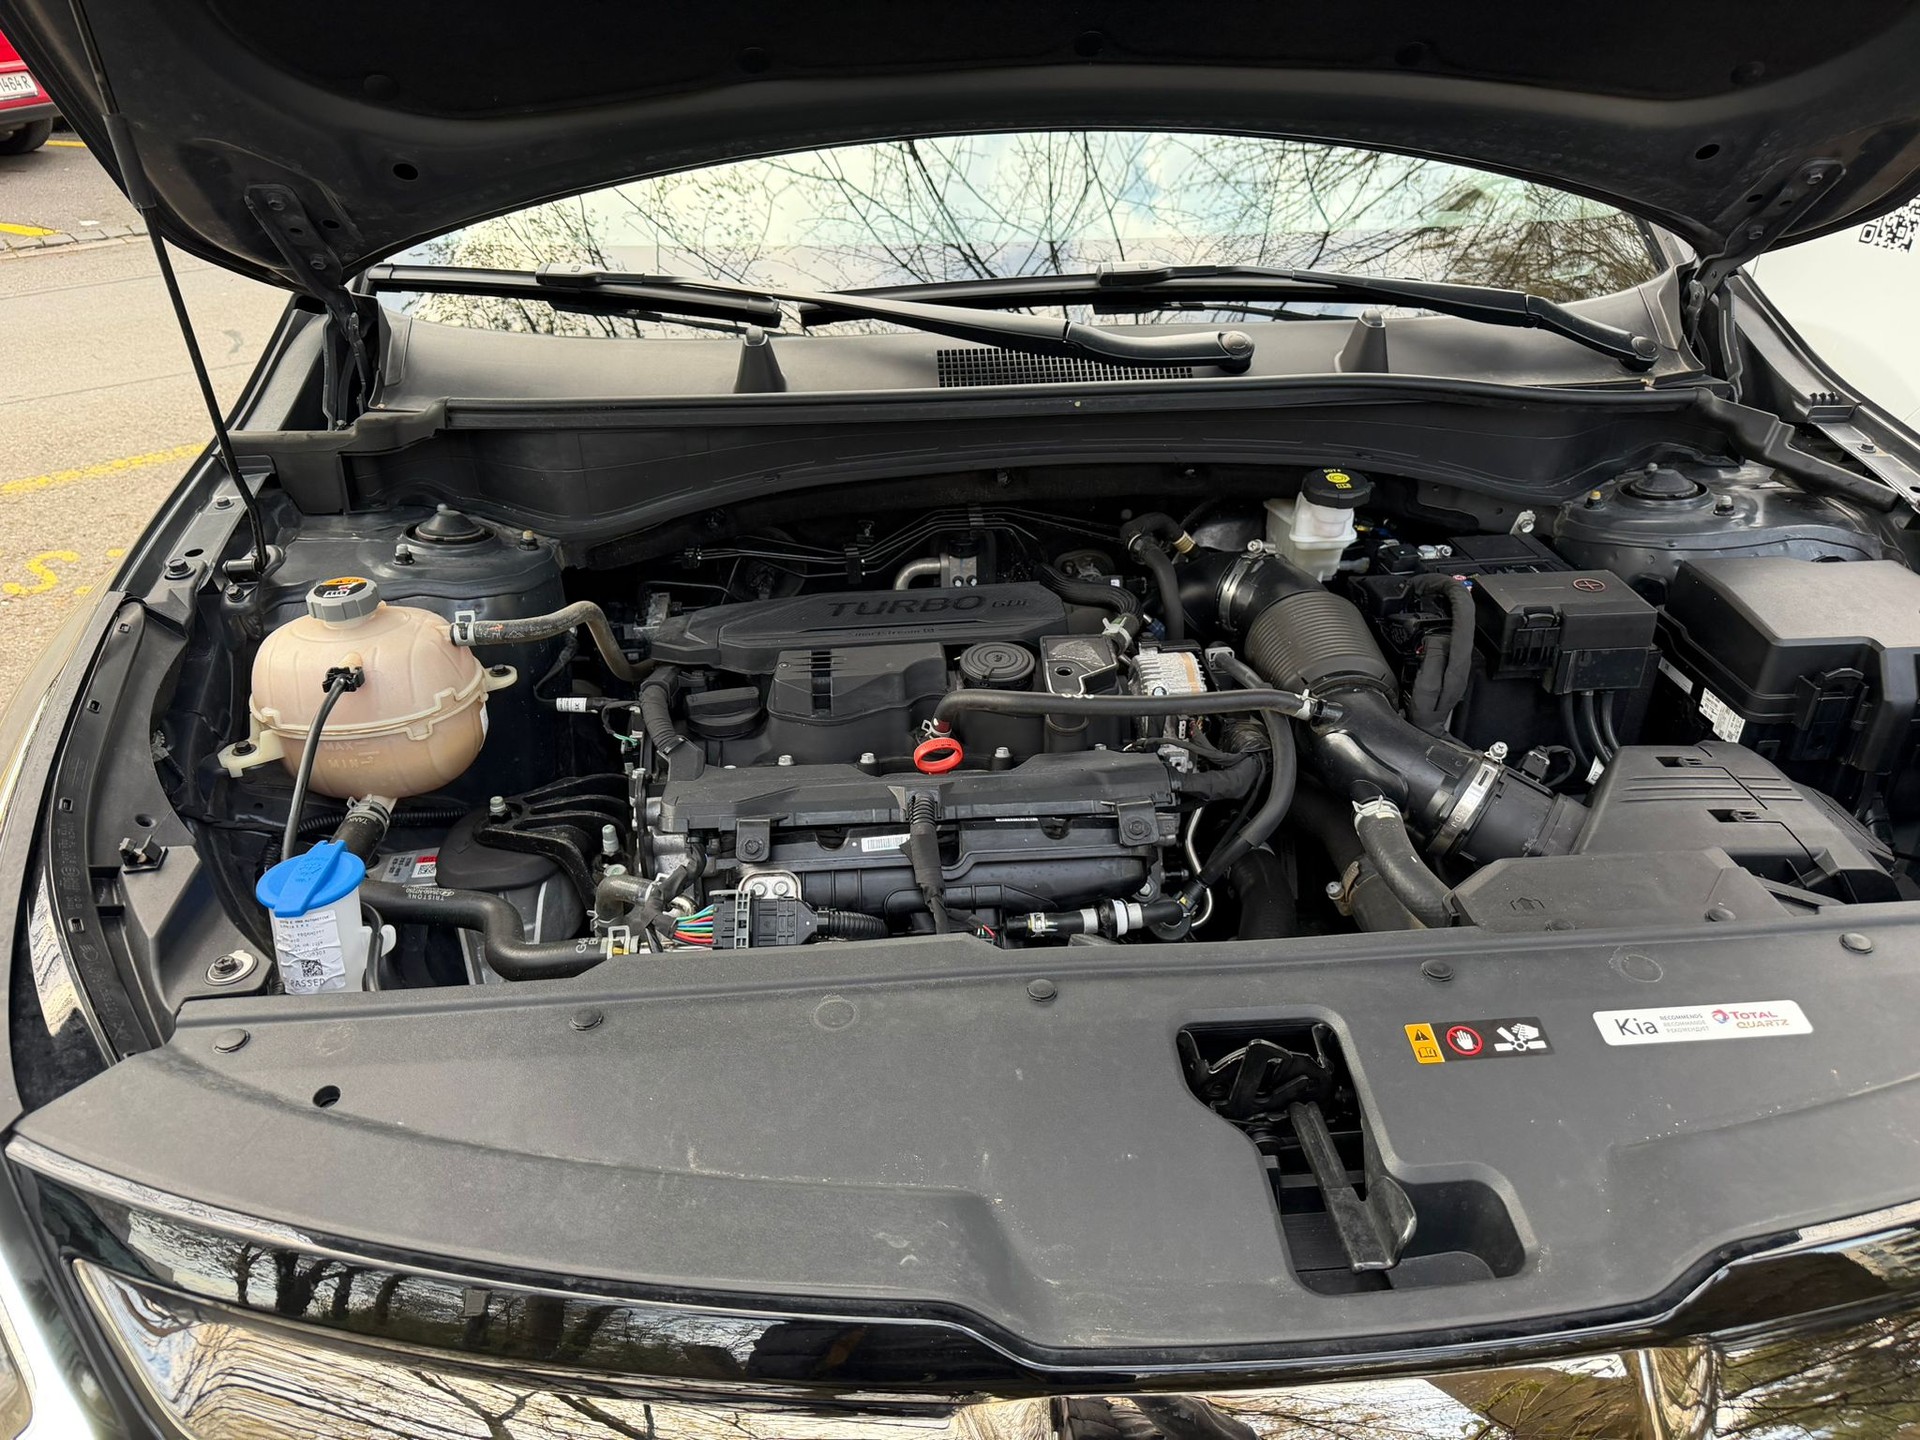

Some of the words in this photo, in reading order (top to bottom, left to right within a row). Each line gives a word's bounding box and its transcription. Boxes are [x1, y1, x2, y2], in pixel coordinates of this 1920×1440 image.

[828, 595, 982, 617] TURBO
[323, 741, 353, 751] MAX
[290, 978, 326, 988] PASSED
[1729, 1010, 1779, 1020] TOTAL
[1614, 1017, 1659, 1036] Kia
[1736, 1018, 1790, 1029] QUARTZ
